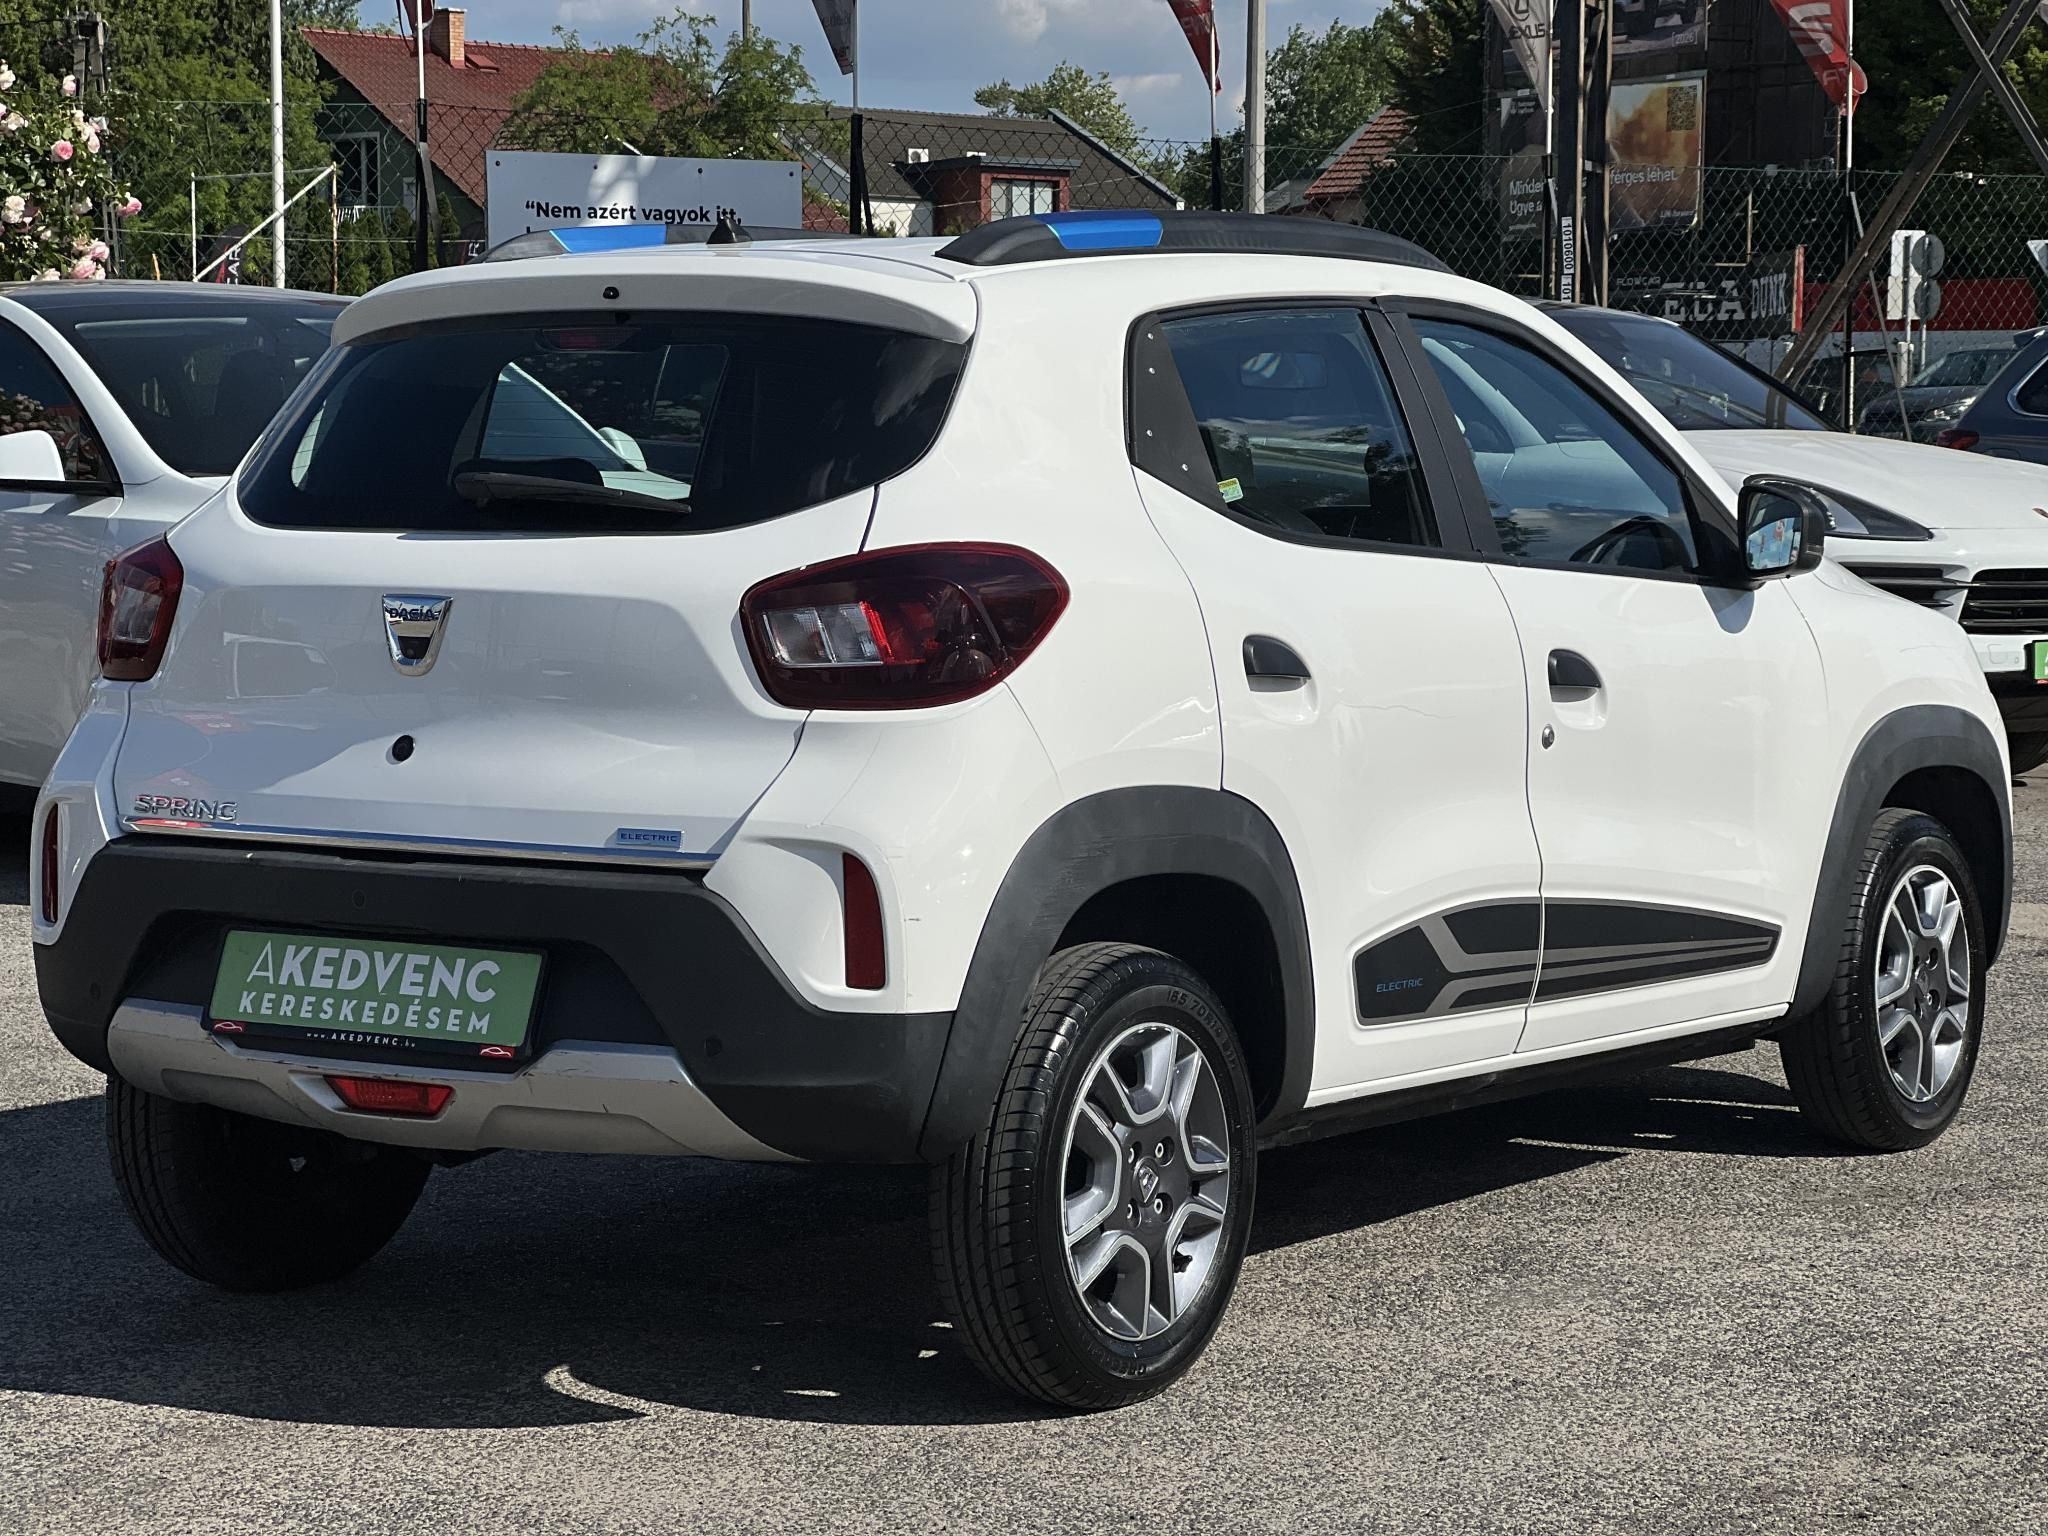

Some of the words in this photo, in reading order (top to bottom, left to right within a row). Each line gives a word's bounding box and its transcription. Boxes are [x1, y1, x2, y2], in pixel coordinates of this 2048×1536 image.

[525, 200, 581, 219] “Nem
[587, 202, 637, 220] azért
[641, 205, 710, 225] vagyok
[1562, 223, 1574, 270] 1010600
[389, 607, 434, 621] DACIA
[133, 793, 238, 822] SPRING
[620, 832, 678, 842] ELECTRIC
[246, 939, 501, 1003] AKEDVENC
[1375, 977, 1425, 993] ELECTRIC
[238, 991, 491, 1035] KERESKEDÉSEM
